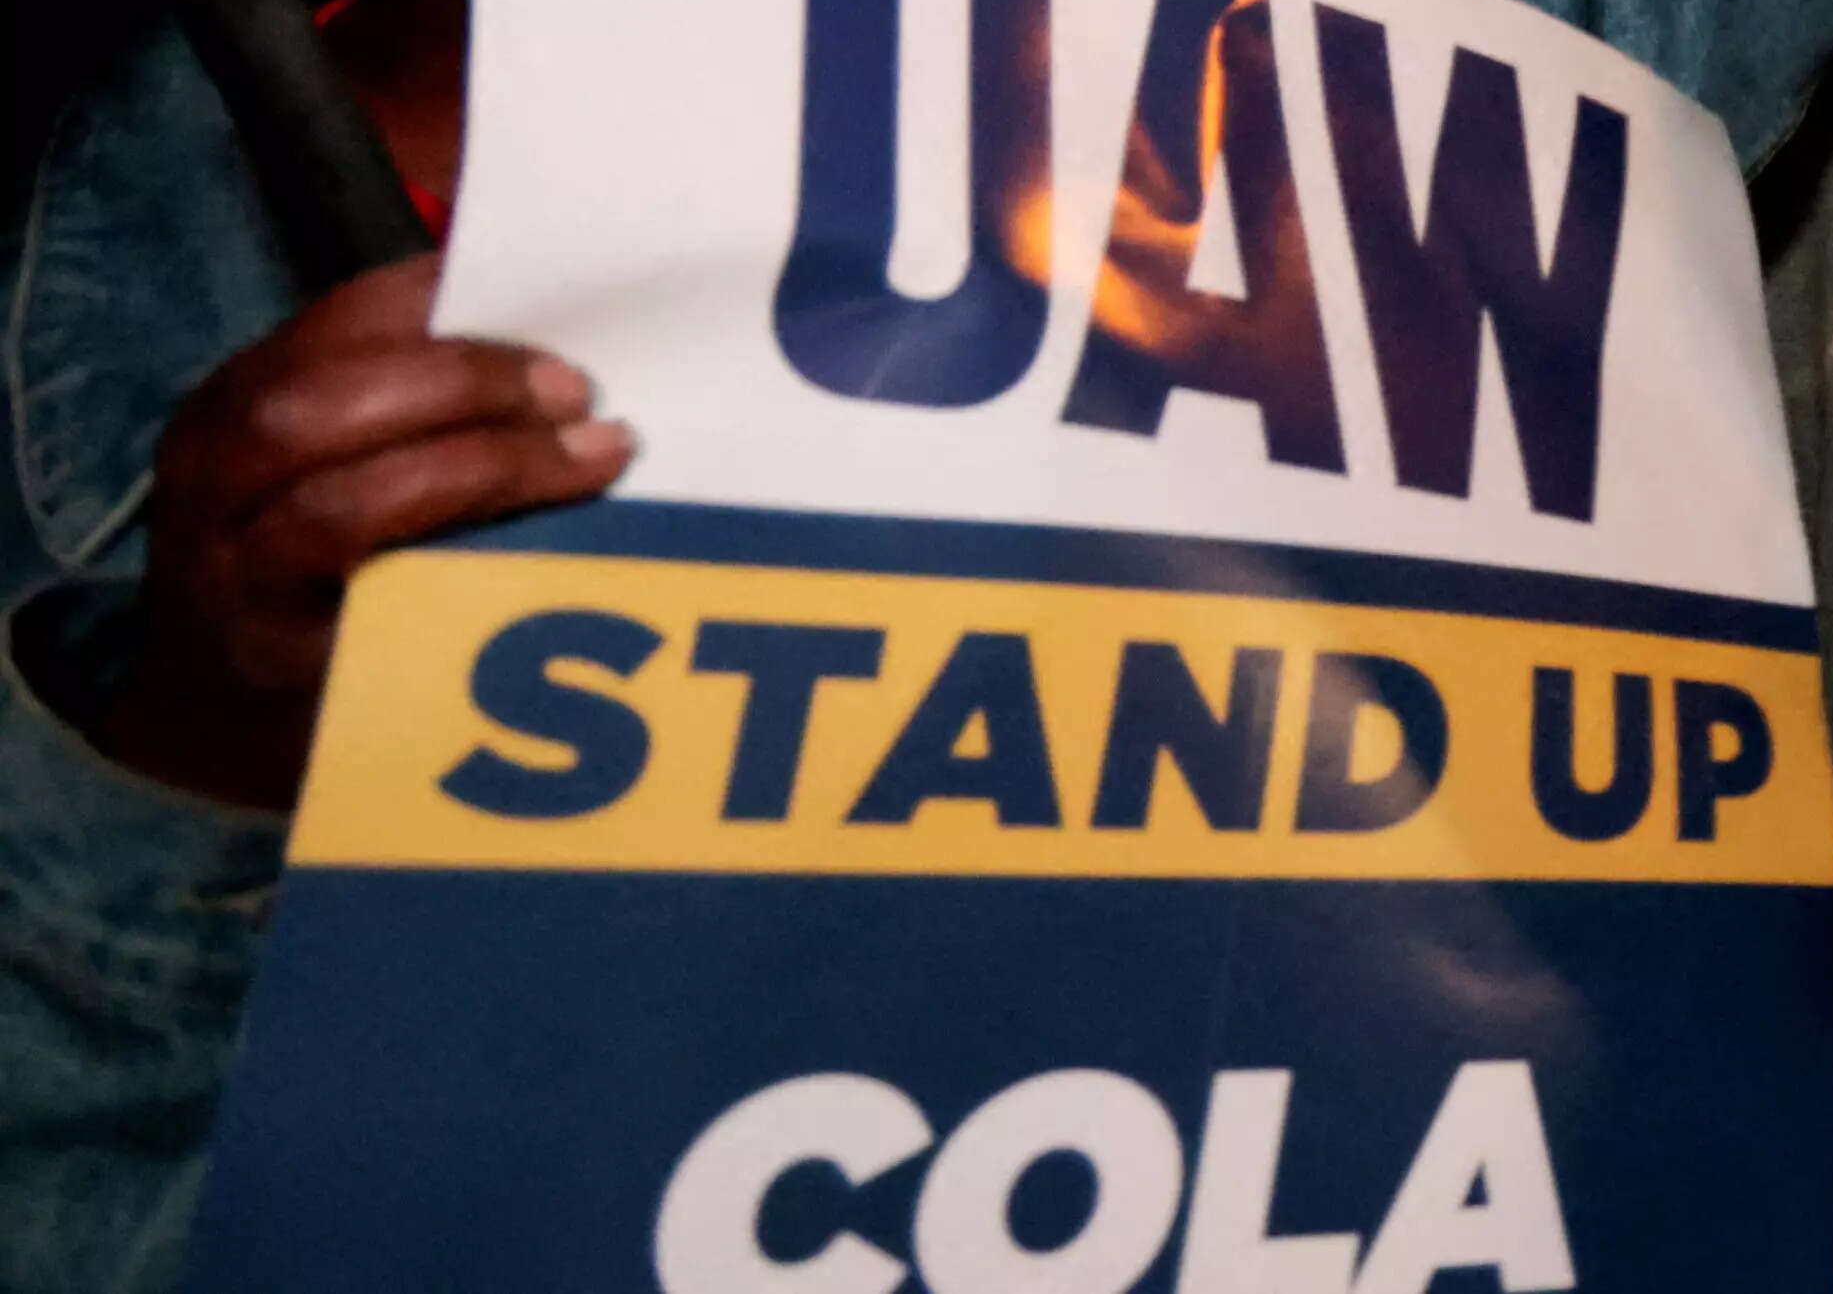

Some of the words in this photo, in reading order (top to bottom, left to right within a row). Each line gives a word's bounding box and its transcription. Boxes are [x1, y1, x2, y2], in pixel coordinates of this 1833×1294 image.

[435, 608, 1452, 835] STAND
[1530, 665, 1776, 844] UP
[653, 1060, 1577, 1294] COLA
